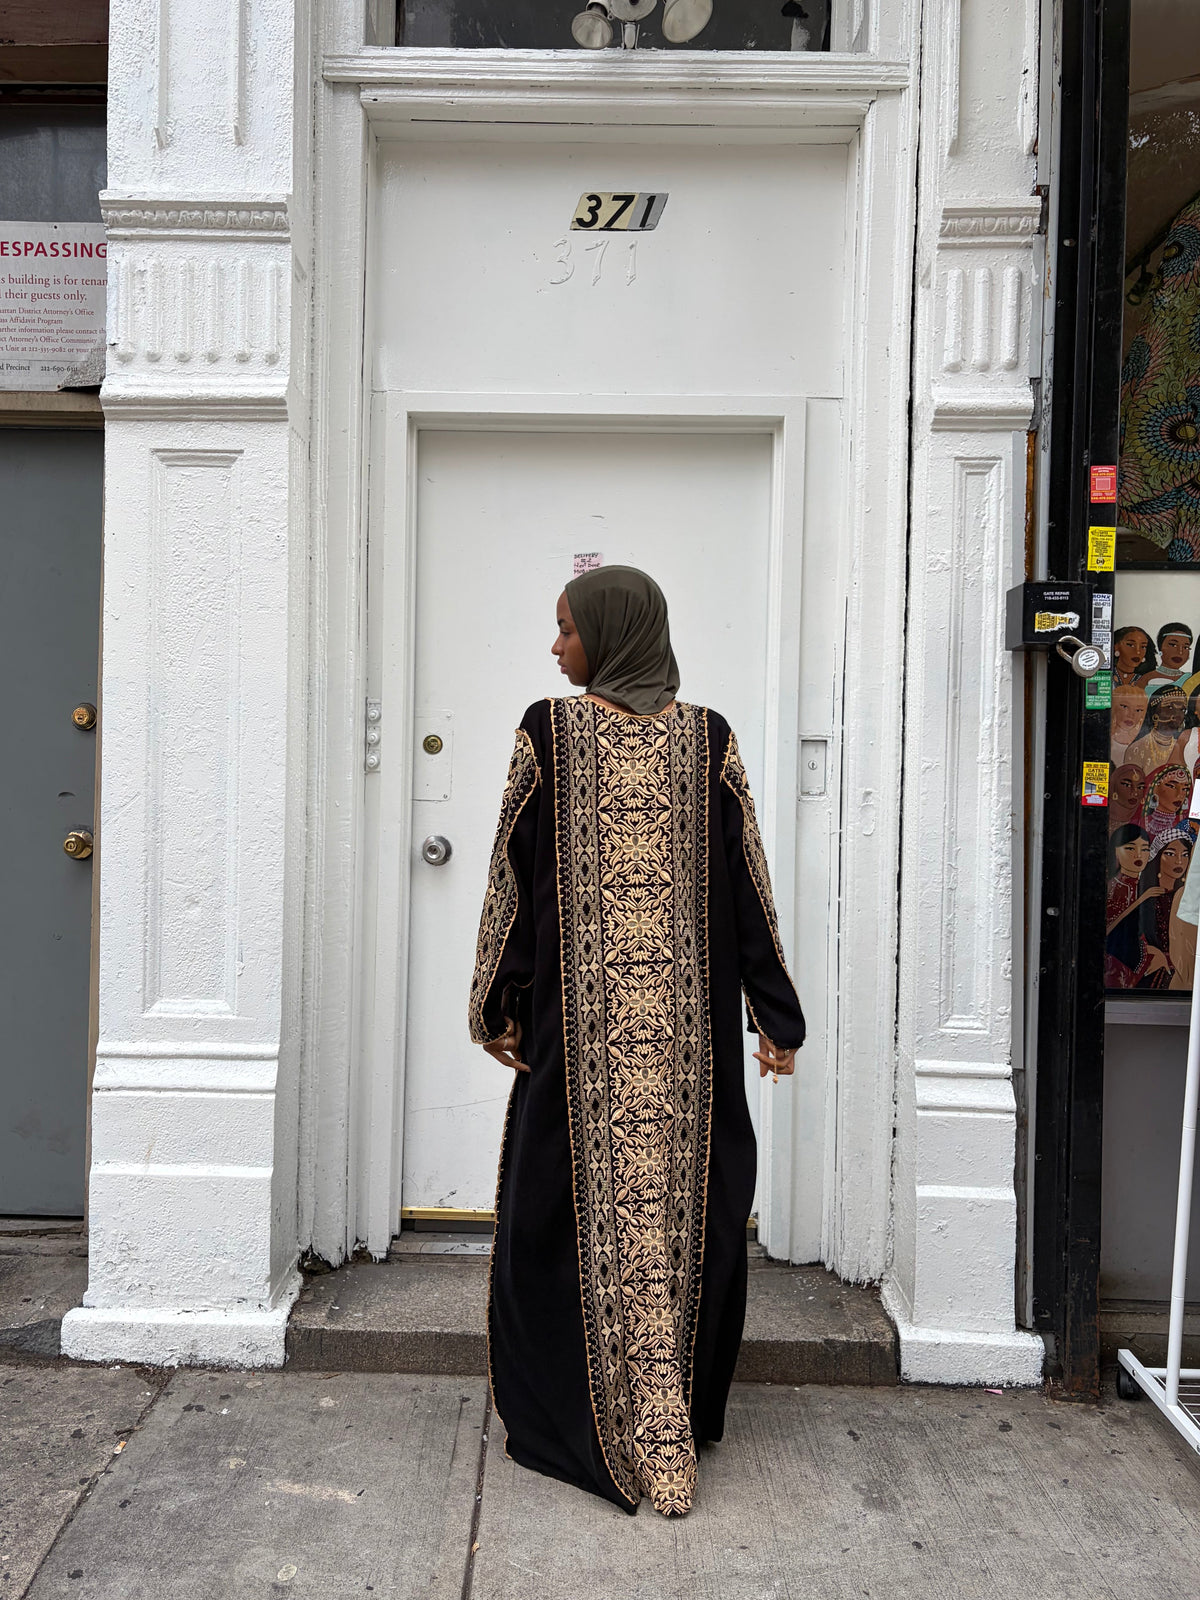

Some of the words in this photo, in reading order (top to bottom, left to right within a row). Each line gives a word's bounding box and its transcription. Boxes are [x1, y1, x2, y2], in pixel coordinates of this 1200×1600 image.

[576, 194, 656, 228] 371
[0, 241, 107, 258] ESPASSING
[550, 236, 638, 287] 371
[8, 273, 50, 287] building
[53, 275, 61, 285] is
[64, 274, 78, 286] for
[5, 289, 28, 299] their
[30, 291, 61, 303] guests
[63, 290, 87, 303] only.
[18, 307, 41, 315] District
[43, 307, 73, 317] Attorney's
[75, 308, 95, 316] Office
[9, 316, 36, 324] Affidavit
[37, 317, 63, 326] Program
[18, 326, 55, 334] information
[56, 327, 74, 336] please
[8, 335, 39, 345] Attorney's
[40, 335, 60, 343] Office
[60, 336, 97, 346] Community
[6, 363, 31, 371] Precinct
